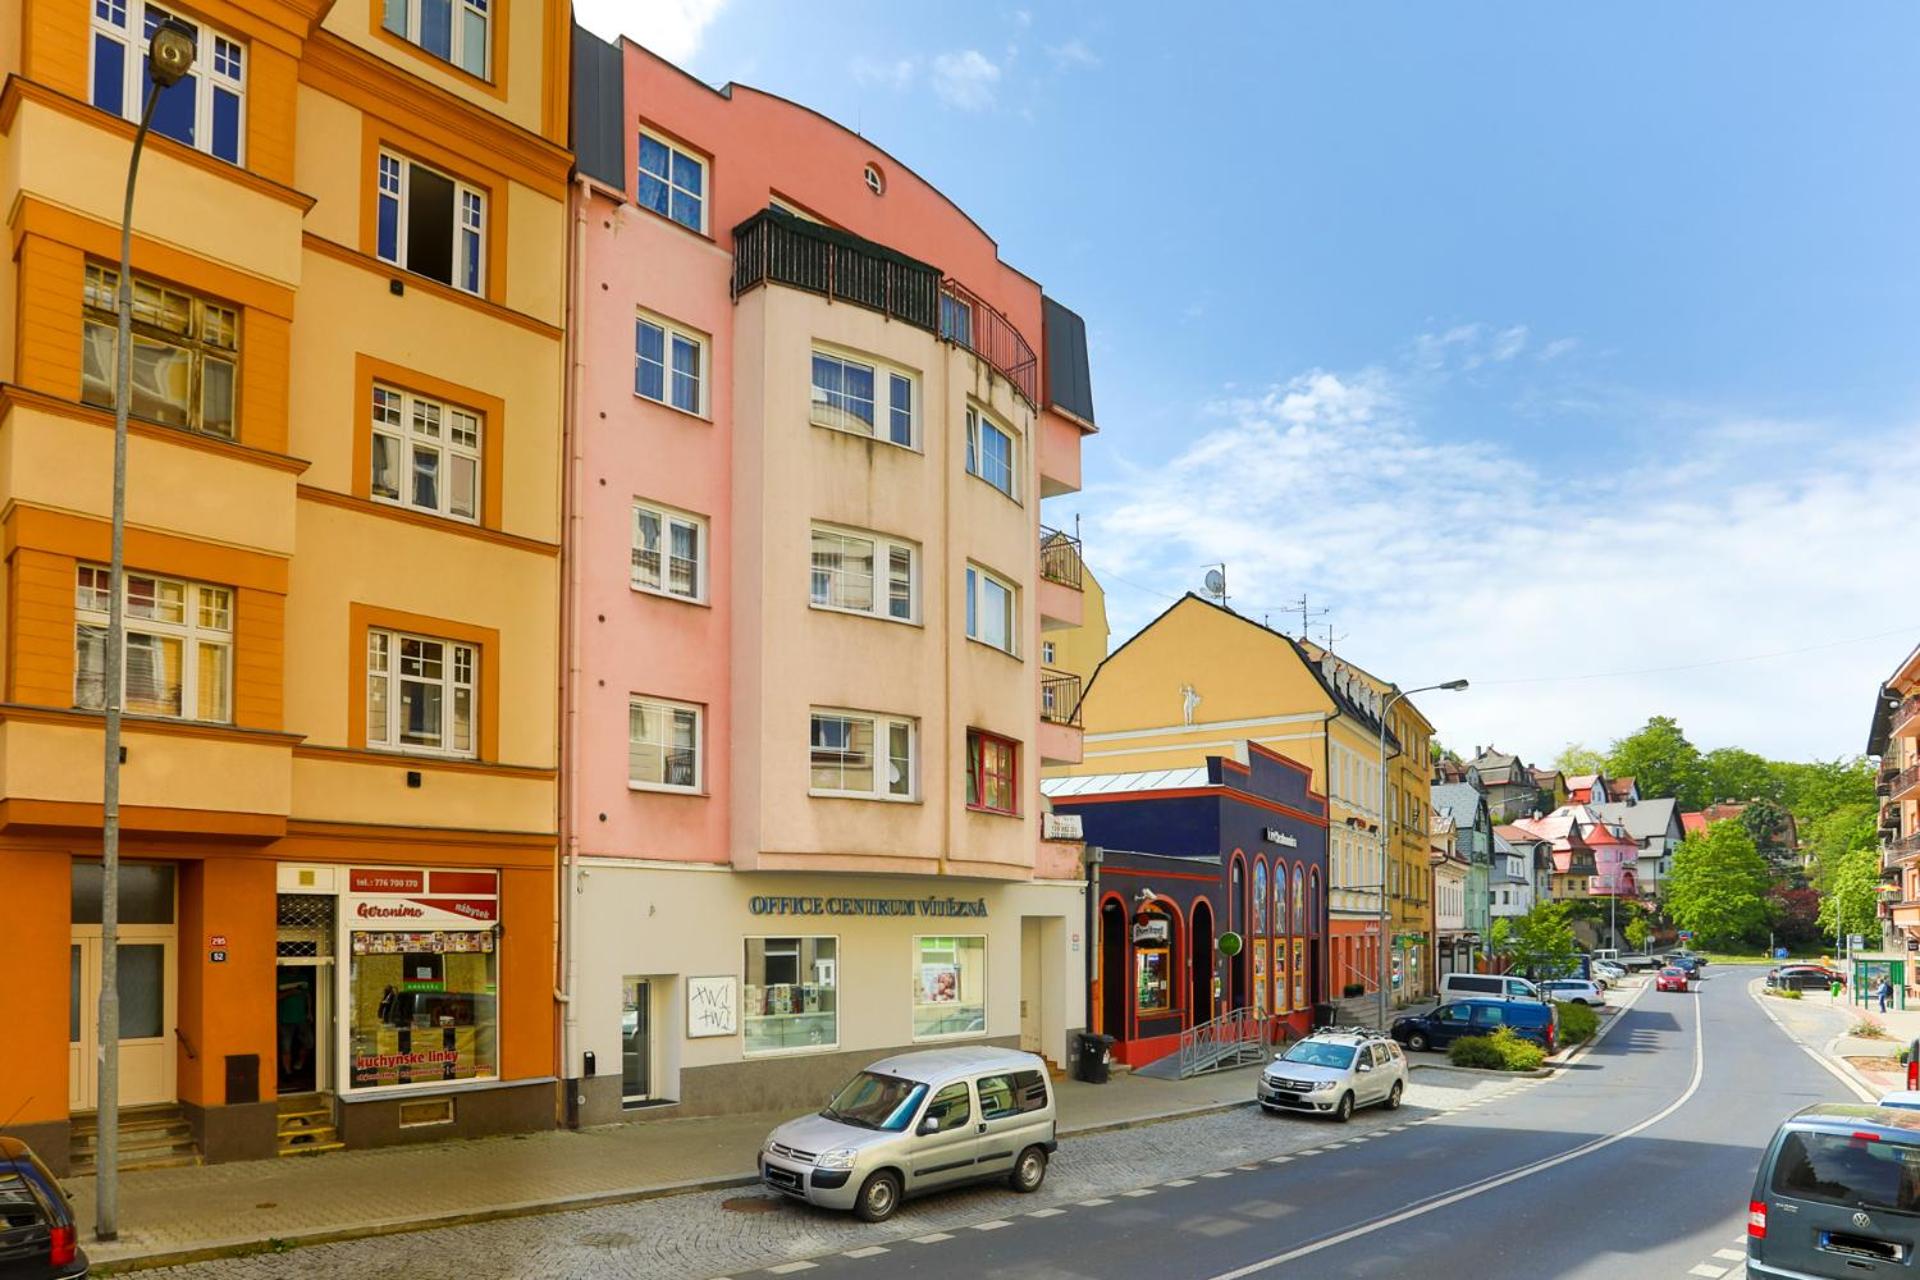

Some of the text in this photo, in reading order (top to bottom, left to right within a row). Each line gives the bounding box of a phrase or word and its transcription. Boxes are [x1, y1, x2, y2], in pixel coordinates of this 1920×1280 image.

[357, 902, 424, 918] Geronimo
[454, 903, 490, 920] nábytek
[750, 896, 988, 917] OFFICE CENTRUM VÍTĚZNÁ
[428, 1050, 459, 1063] linky
